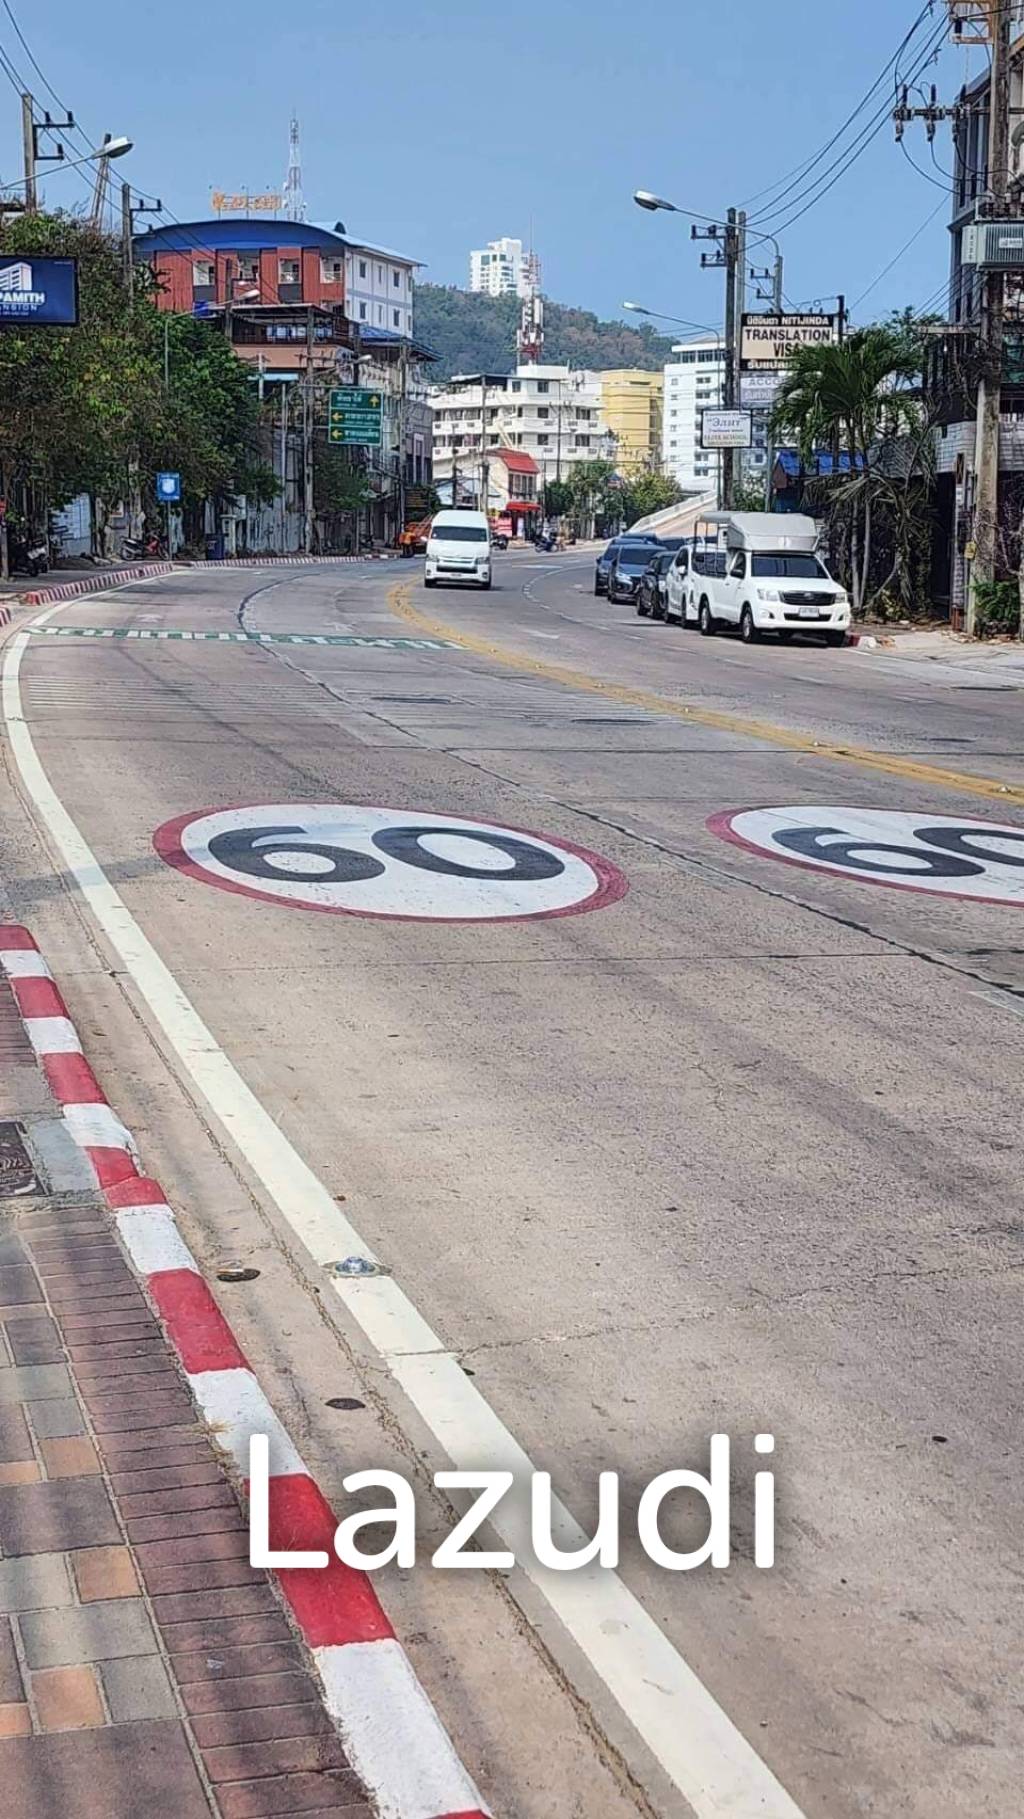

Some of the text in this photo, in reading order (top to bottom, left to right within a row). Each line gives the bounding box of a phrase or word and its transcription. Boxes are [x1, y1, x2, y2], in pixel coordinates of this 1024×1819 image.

[781, 316, 829, 325] NITIJINDA
[745, 329, 830, 341] TRANSLATION
[773, 342, 800, 357] VISA
[208, 826, 566, 883] 60
